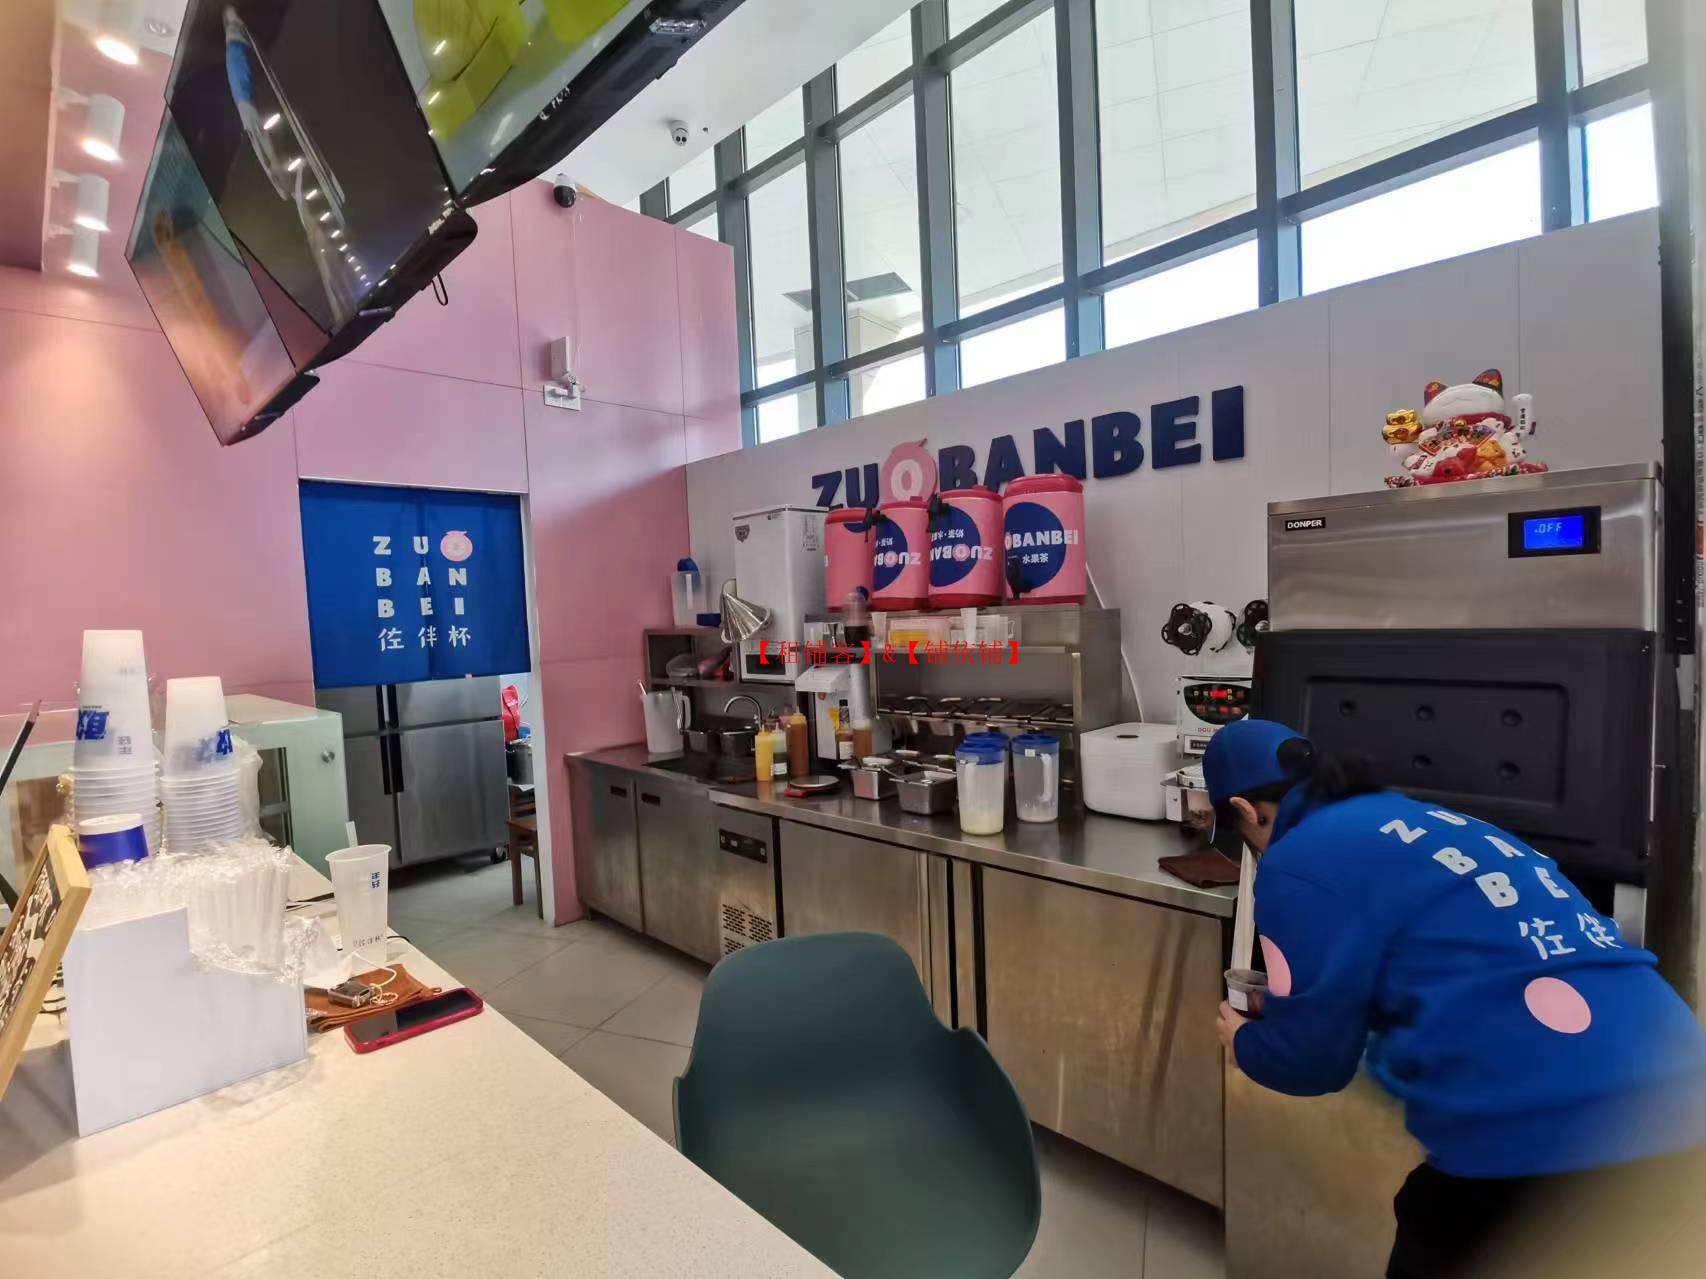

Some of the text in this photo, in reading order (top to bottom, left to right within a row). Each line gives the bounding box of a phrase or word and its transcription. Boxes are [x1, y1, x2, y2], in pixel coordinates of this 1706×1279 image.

[811, 385, 1245, 508] ZUOBANBEI
[1286, 519, 1323, 530] DONPER
[1022, 552, 1049, 564] 水果茶
[375, 566, 467, 587] BAN
[377, 597, 465, 618] BEI
[378, 624, 471, 652] 佐伴杯
[1518, 912, 1622, 961] 佐伴
